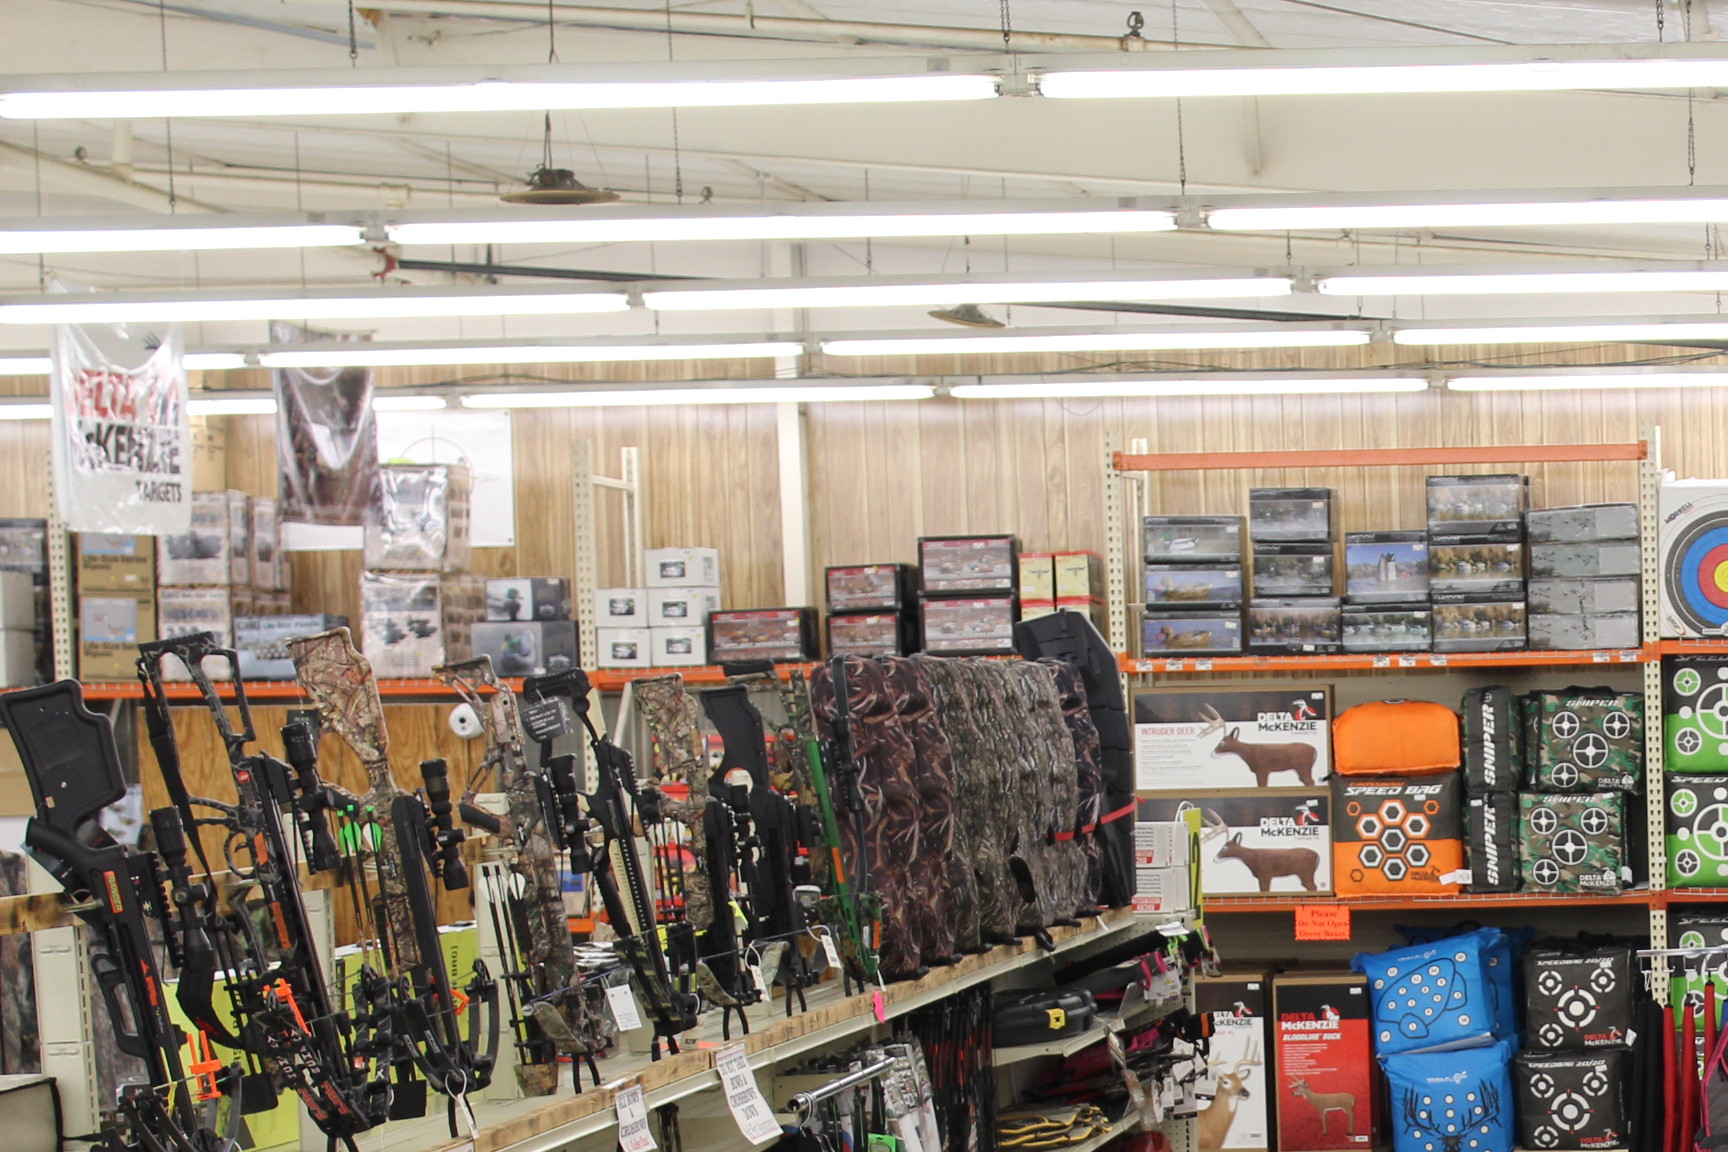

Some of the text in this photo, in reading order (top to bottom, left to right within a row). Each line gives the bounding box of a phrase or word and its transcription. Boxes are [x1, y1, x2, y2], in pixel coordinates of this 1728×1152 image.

[136, 480, 181, 502] TARGETS
[1257, 712, 1293, 722] DELTA
[1141, 726, 1195, 736] INTRUDER DEER
[1258, 722, 1317, 732] McKENZIE
[1482, 702, 1497, 786] SNIPER
[1671, 775, 1728, 784] SPEED
[1344, 784, 1443, 796] SPEED BAG
[1260, 817, 1295, 827] DELTA
[1260, 827, 1319, 837] McKENZIE
[1486, 802, 1500, 886] SNIPER
[1579, 873, 1601, 881] DELTA
[1311, 909, 1338, 918] Please
[1327, 920, 1348, 929] Open
[1536, 956, 1615, 966] SPEEDBAG 20/20
[1213, 1010, 1234, 1018] ELTA
[1281, 1012, 1315, 1021] DELTA
[1281, 1020, 1340, 1030] McKENZIE
[1322, 1032, 1342, 1041] BUCK
[1584, 1033, 1609, 1041] DELTA
[1584, 1039, 1624, 1047] McKENZIE
[1527, 1060, 1574, 1068] SPEEDBAG
[1580, 1140, 1620, 1149] McKENZIE
